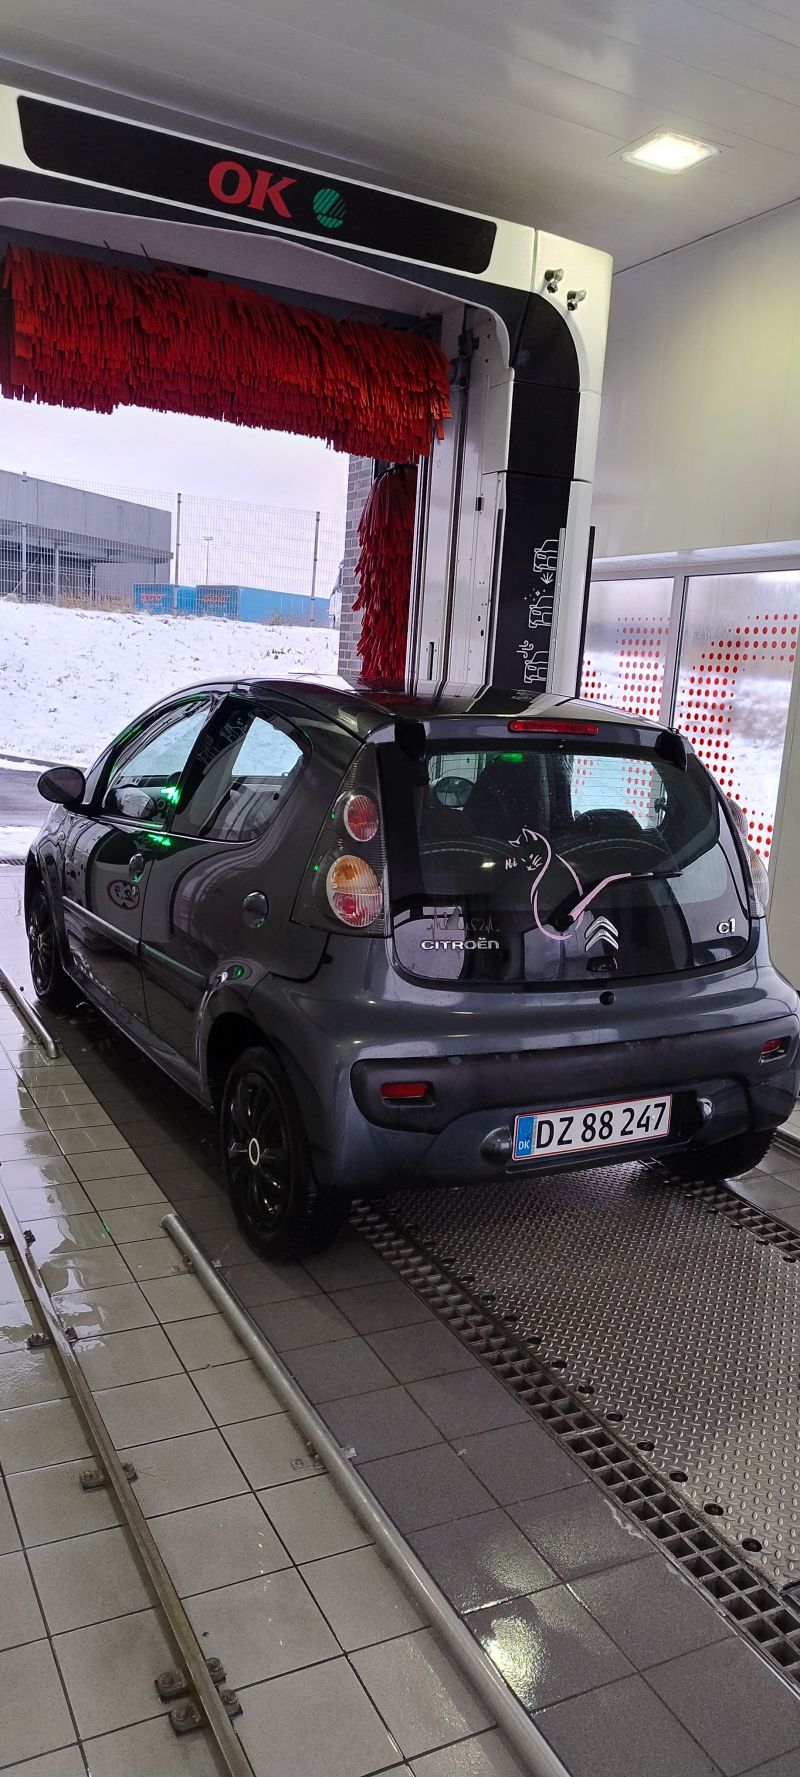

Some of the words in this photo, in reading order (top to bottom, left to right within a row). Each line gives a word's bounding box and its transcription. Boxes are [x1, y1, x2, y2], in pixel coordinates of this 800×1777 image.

[209, 161, 296, 218] OK
[505, 858, 517, 869] Hi
[536, 1116, 574, 1149] DZ
[580, 1110, 614, 1143] 88
[620, 1102, 667, 1136] 247
[518, 1140, 530, 1150] DK
